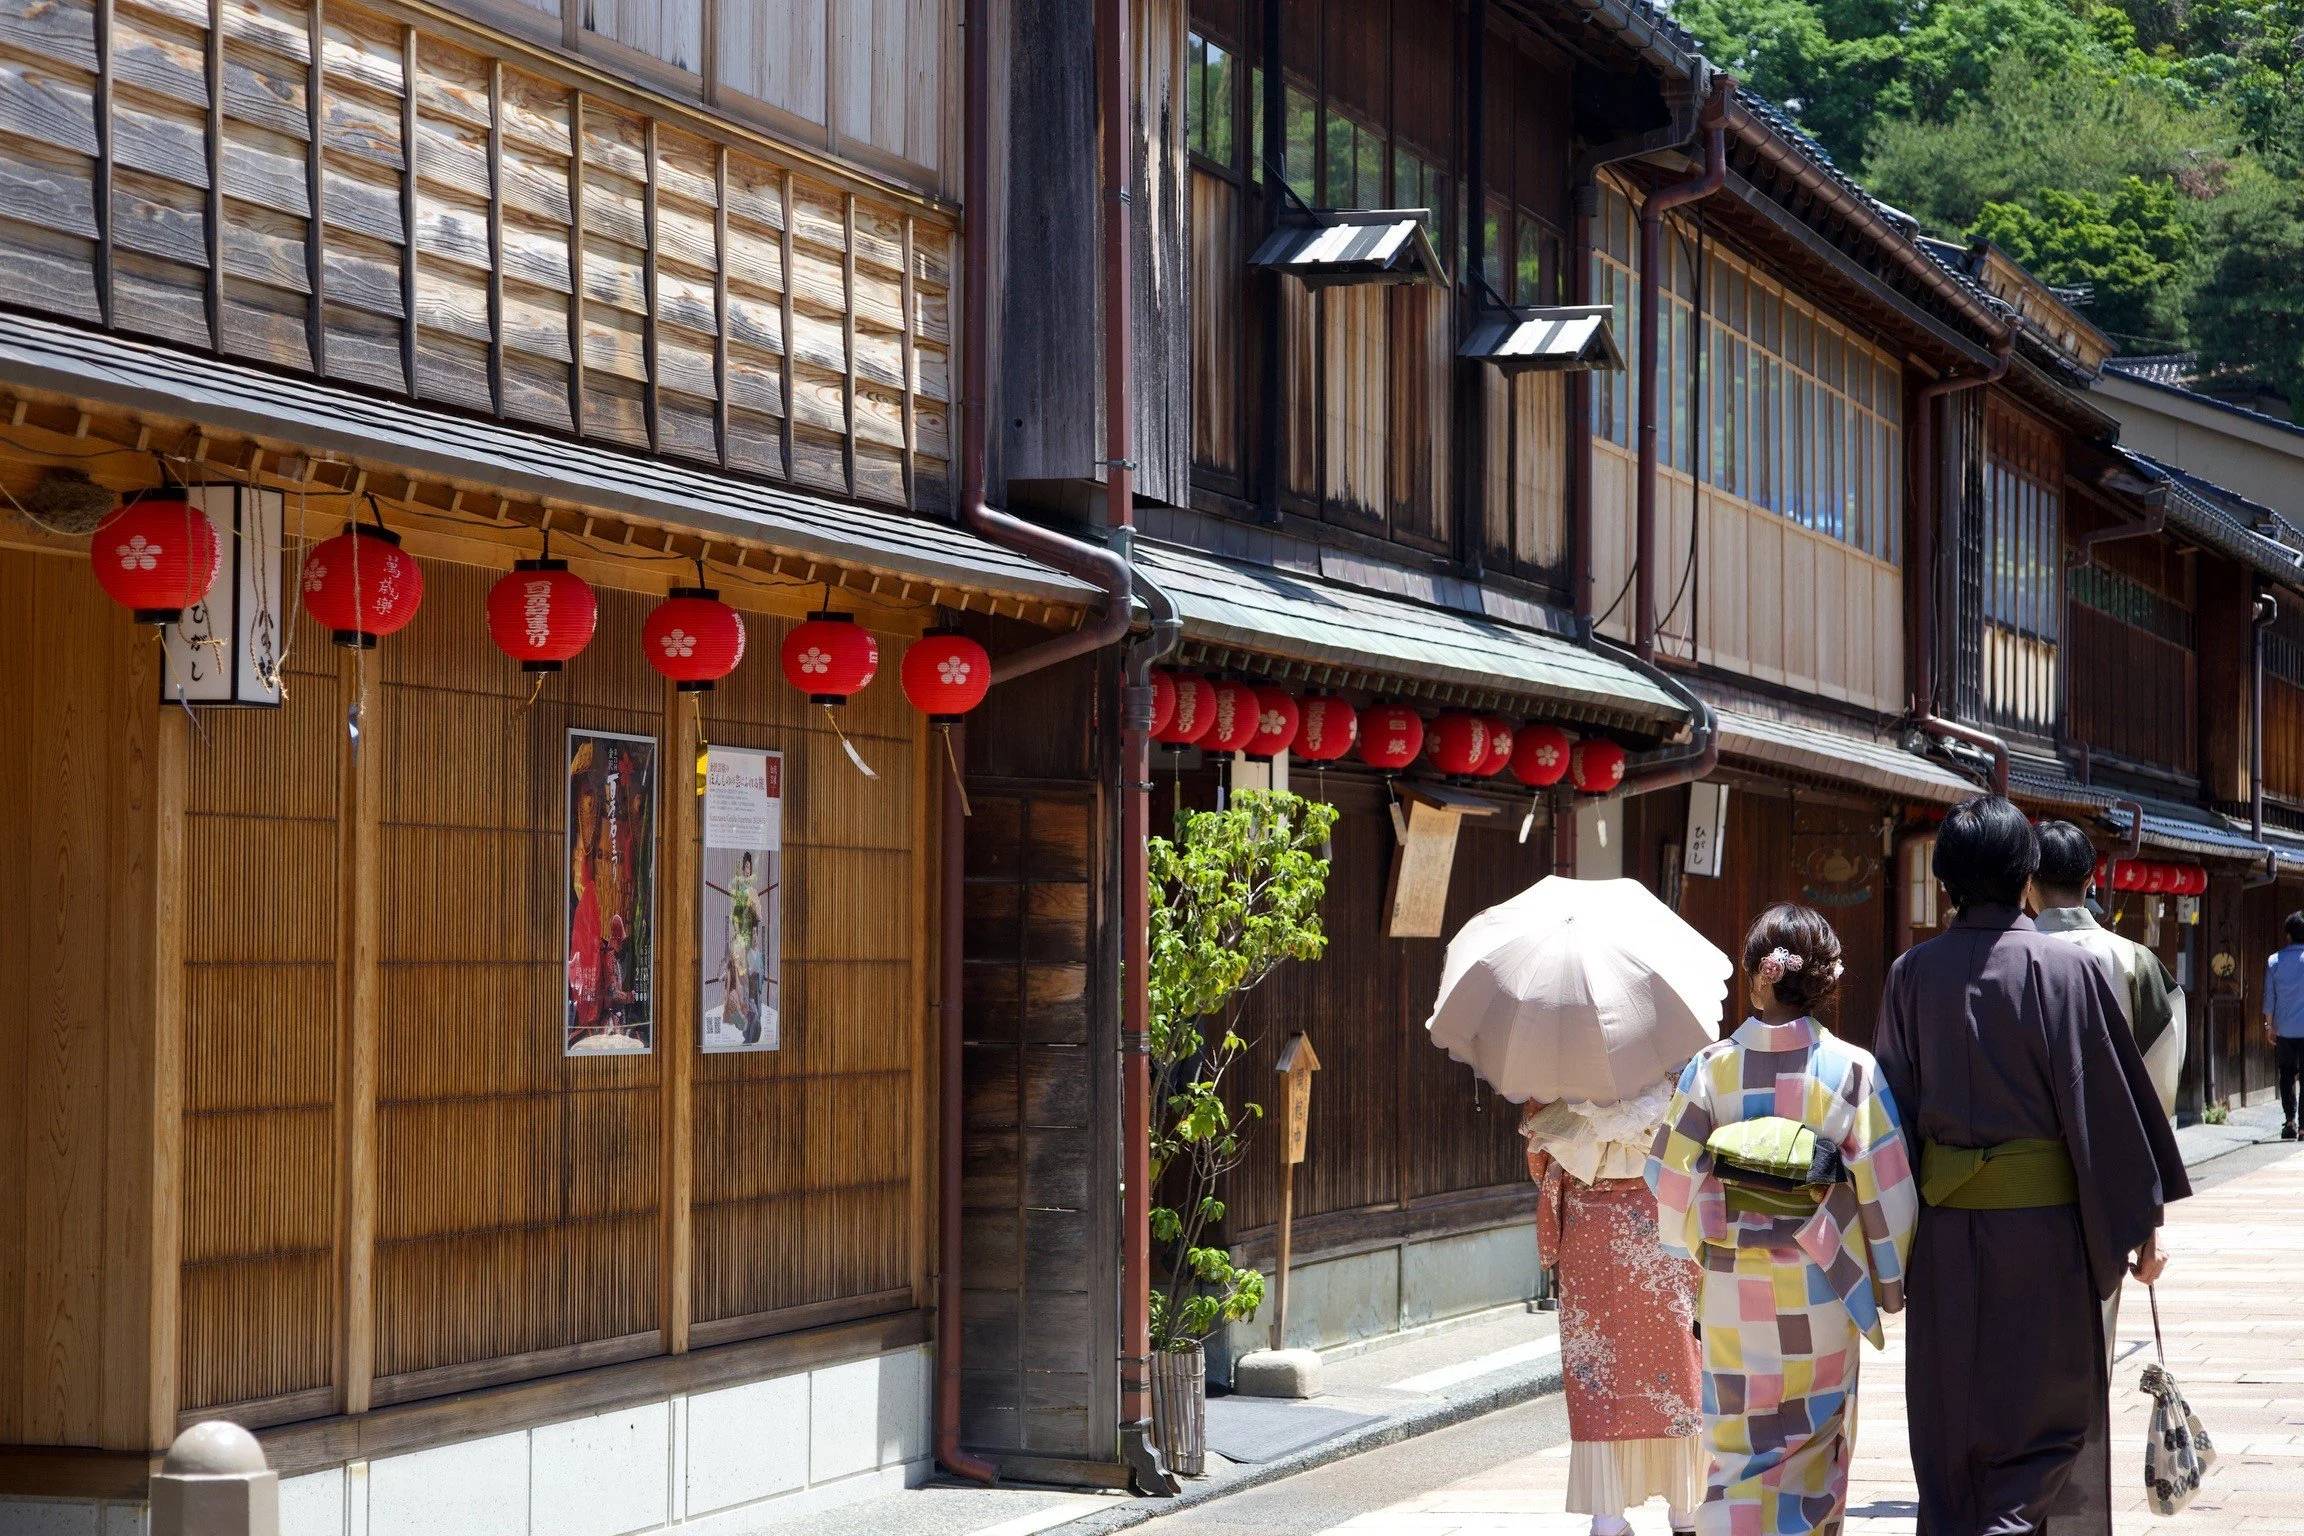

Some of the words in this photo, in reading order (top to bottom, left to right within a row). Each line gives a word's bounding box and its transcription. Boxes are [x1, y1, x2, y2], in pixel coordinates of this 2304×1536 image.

[190, 604, 208, 682] ひがし
[1692, 825, 1706, 865] ひがし
